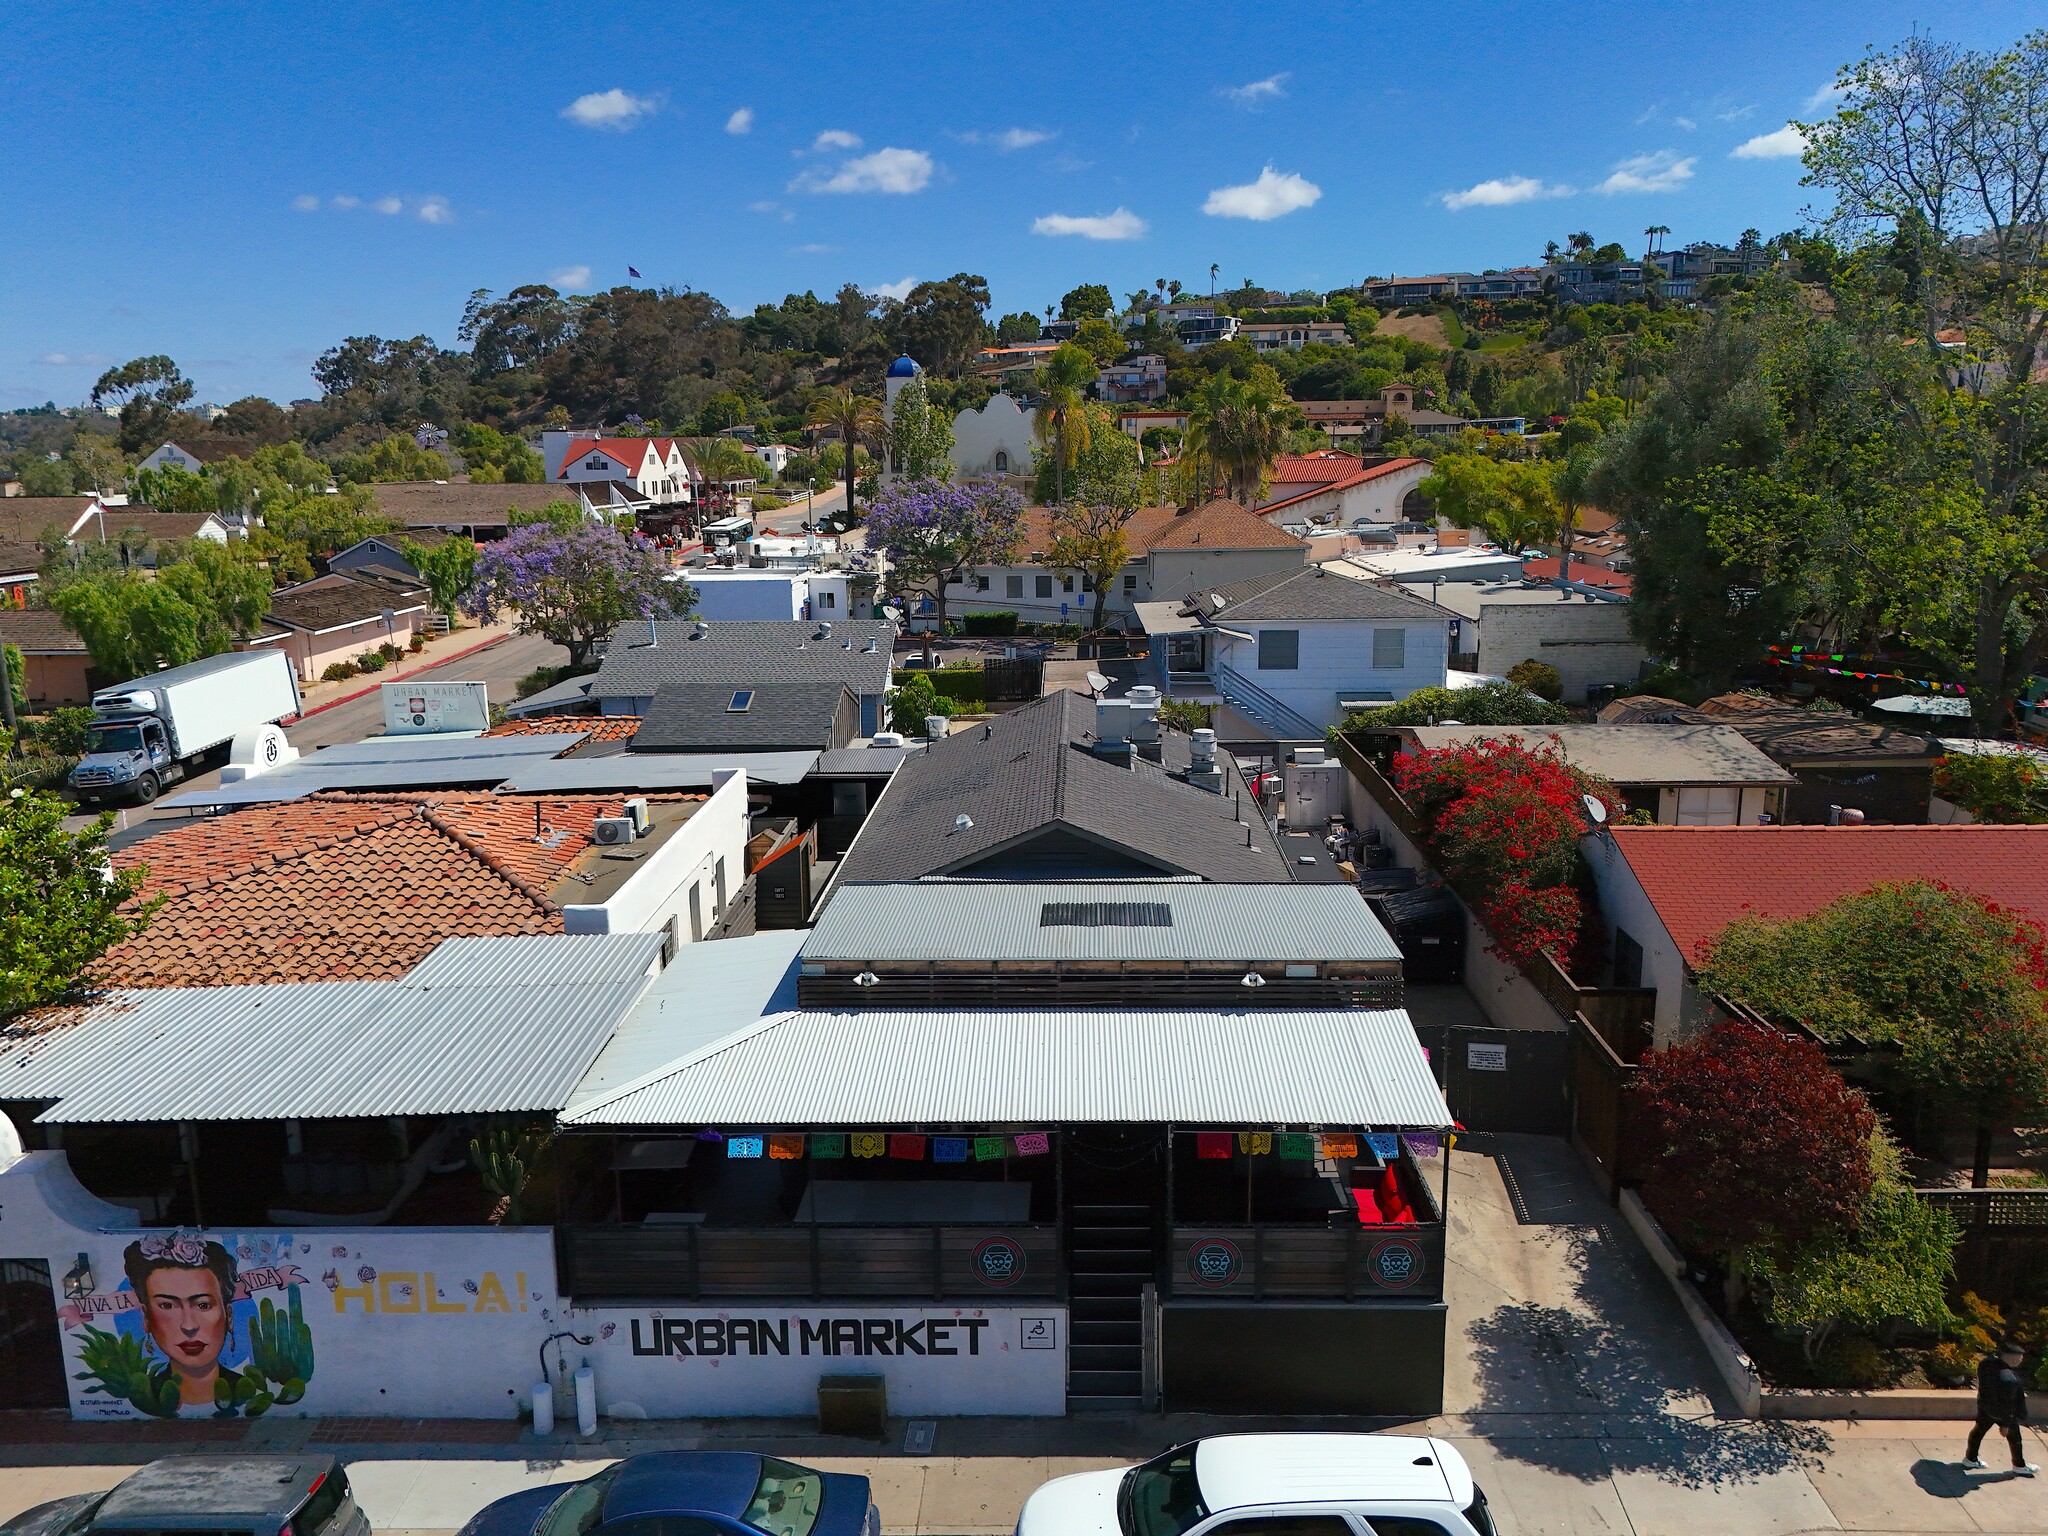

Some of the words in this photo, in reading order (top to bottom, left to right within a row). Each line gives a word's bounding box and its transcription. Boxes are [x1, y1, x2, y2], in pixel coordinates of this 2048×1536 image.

[393, 687, 427, 697] URBAN
[433, 687, 473, 697] MARKET
[78, 1298, 112, 1312] VIVA
[115, 1294, 135, 1309] LA
[333, 1272, 527, 1313] HOLA!
[631, 1319, 790, 1356] URBAN
[800, 1319, 989, 1356] MARKET
